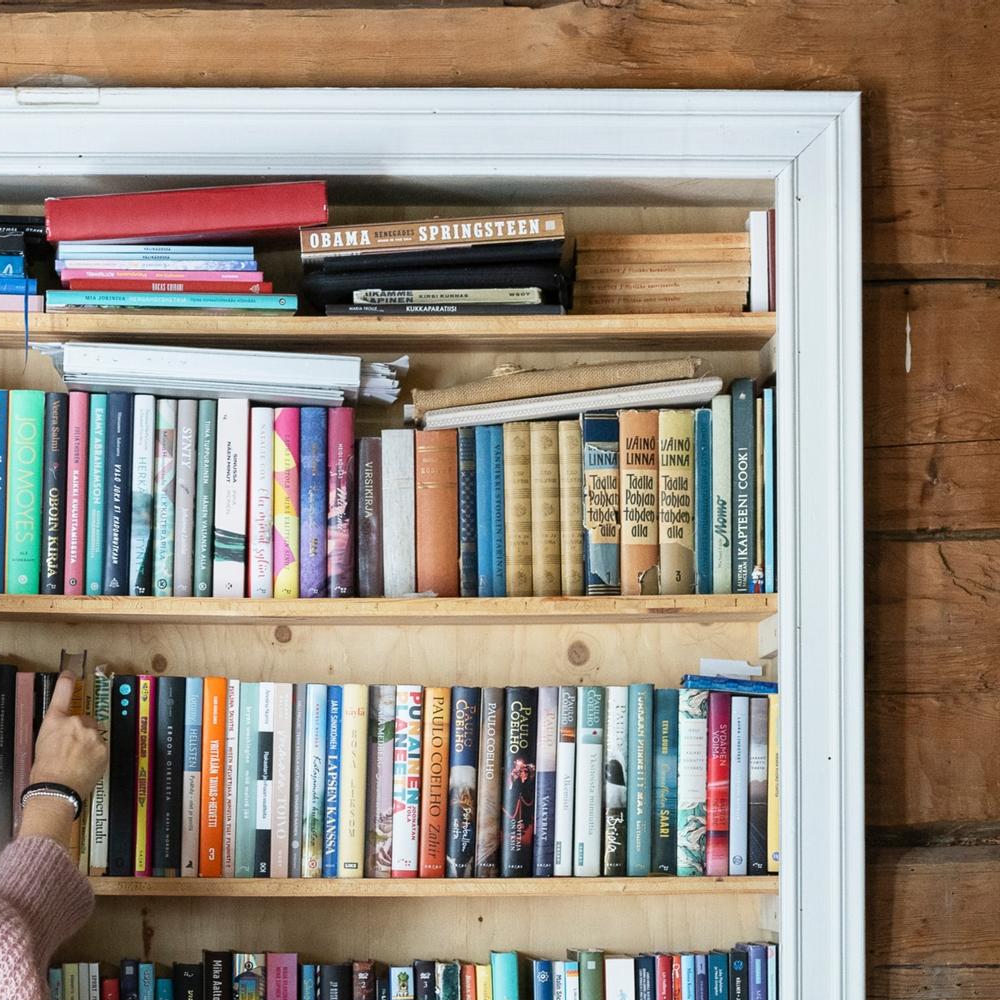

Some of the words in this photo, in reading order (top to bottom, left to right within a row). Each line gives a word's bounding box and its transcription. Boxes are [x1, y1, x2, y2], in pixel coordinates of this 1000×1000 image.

[310, 230, 370, 248] OBAMA
[419, 219, 540, 242] SPRINGSTEEN
[52, 400, 60, 425] Veera
[94, 408, 103, 434] EMMY
[15, 416, 36, 465] JOJO
[51, 426, 59, 452] Salmi
[181, 427, 192, 469] SYNTY
[626, 437, 656, 451] VÄINÖ
[660, 437, 690, 452] VÄINÖ
[93, 437, 102, 504] ABRAHAMSON
[589, 453, 617, 466] LINNA
[626, 453, 655, 466] LINNA
[661, 453, 690, 467] LINNA
[738, 452, 748, 490] COOK
[16, 469, 36, 543] MOYES
[364, 461, 373, 518] VIRSIKIRJA
[631, 524, 648, 538] alla
[667, 525, 684, 539] alla
[715, 495, 729, 547] Momo
[738, 494, 748, 555] KAPTEENI
[47, 536, 58, 578] KIRJA
[675, 571, 681, 583] 3
[330, 700, 338, 714] JARI
[431, 697, 444, 748] PAULO
[455, 699, 467, 753] COELHO
[487, 703, 496, 735] PAULO
[587, 689, 595, 727] COELHO
[464, 706, 476, 747] PAULO
[509, 701, 521, 754] COELHO
[520, 706, 531, 749] PAULO
[719, 724, 727, 766] SYDÄMEN
[189, 728, 198, 768] HELLSTEN
[210, 740, 220, 774] YRITTÄJÄN
[393, 692, 408, 814] PLANEETTA
[407, 692, 421, 804] PUNAINEN
[486, 738, 495, 780] COELHO
[326, 754, 338, 803] LAPSEN
[430, 752, 442, 817] COELHO
[96, 818, 106, 844] laulu
[325, 807, 337, 855] KANSSA
[511, 819, 516, 829] ON
[541, 796, 550, 842] VALKYRIAT
[660, 810, 669, 837] SAARI
[428, 823, 440, 859] Zahir
[213, 960, 222, 979] Mika
